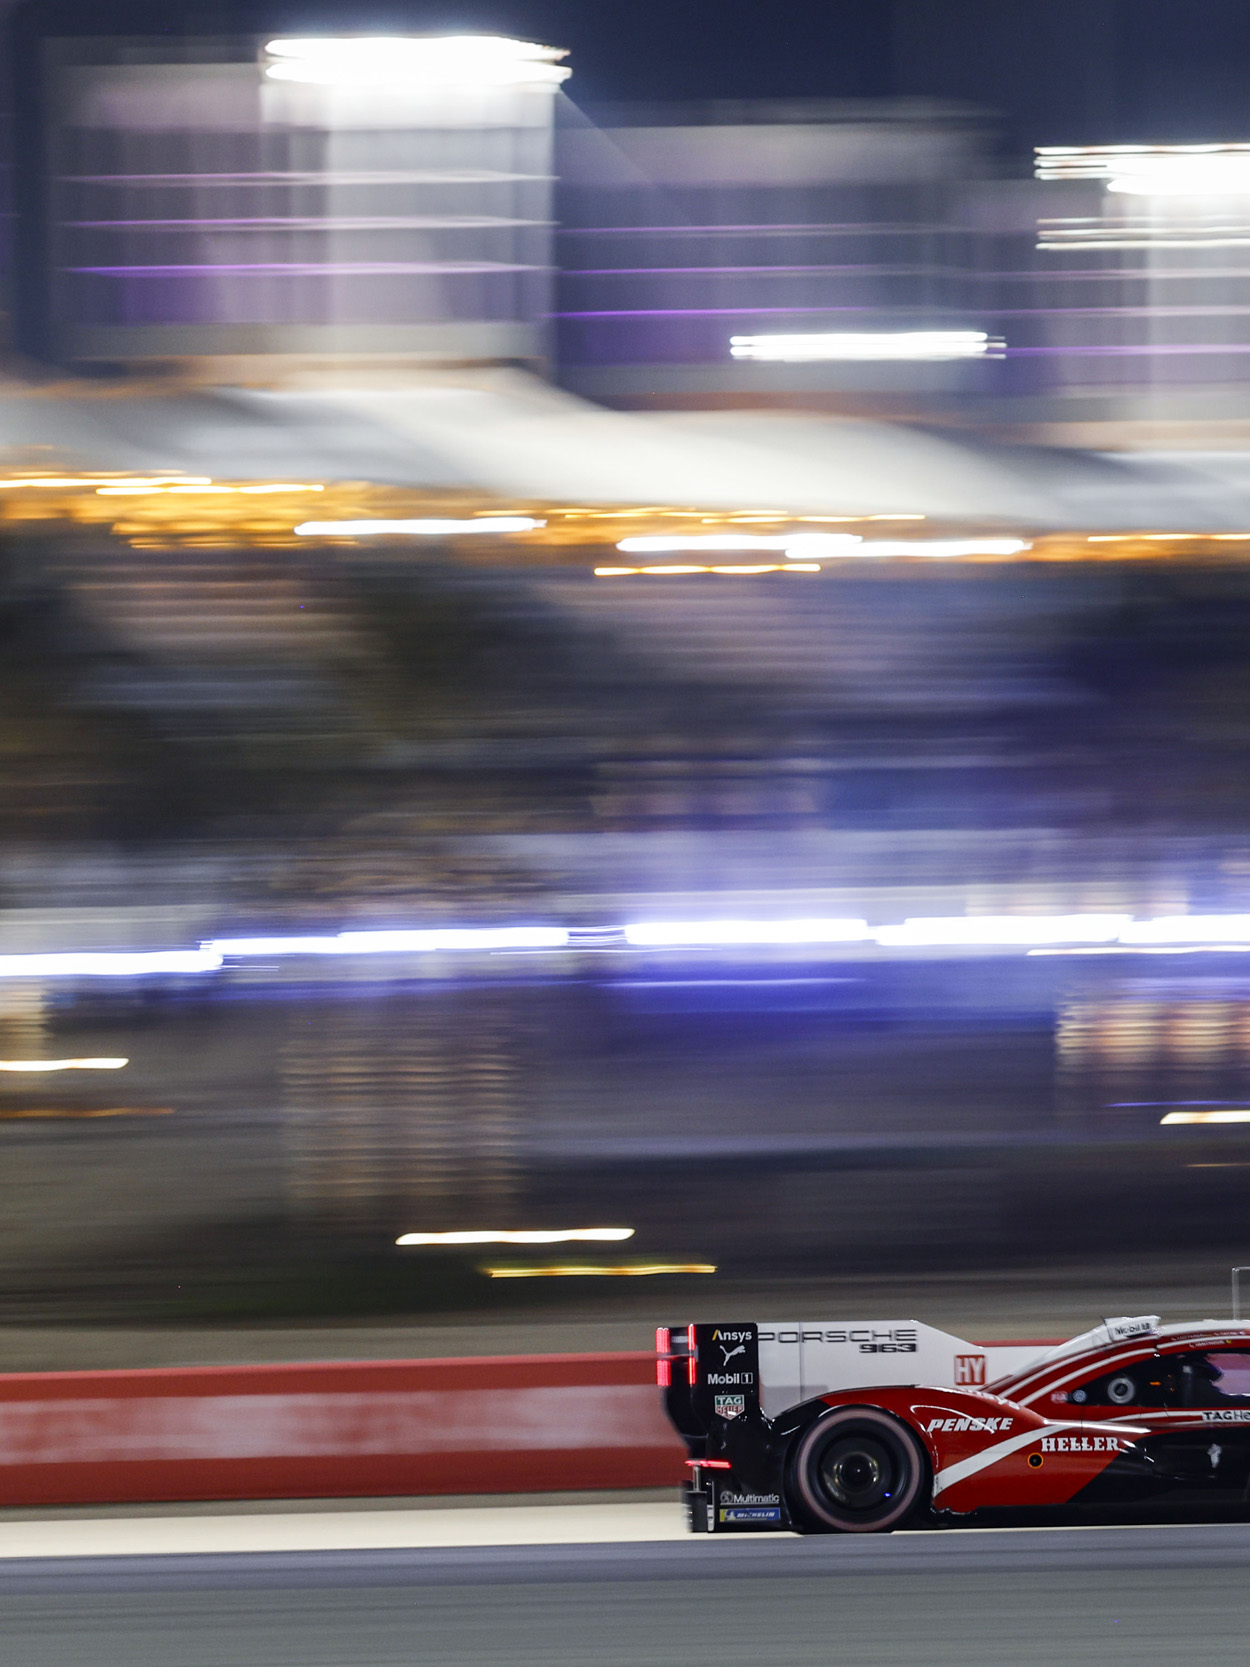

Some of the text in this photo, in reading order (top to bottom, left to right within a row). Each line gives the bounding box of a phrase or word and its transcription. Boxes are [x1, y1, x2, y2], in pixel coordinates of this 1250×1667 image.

[712, 1330, 752, 1343] Ansys
[757, 1330, 916, 1343] PORSCHE
[859, 1344, 916, 1353] 963
[956, 1358, 984, 1384] HY
[707, 1373, 740, 1385] Mobil
[718, 1396, 742, 1405] TAG
[927, 1418, 1013, 1432] PENSKE
[1041, 1437, 1120, 1452] HELLER
[734, 1494, 779, 1503] Multimatic
